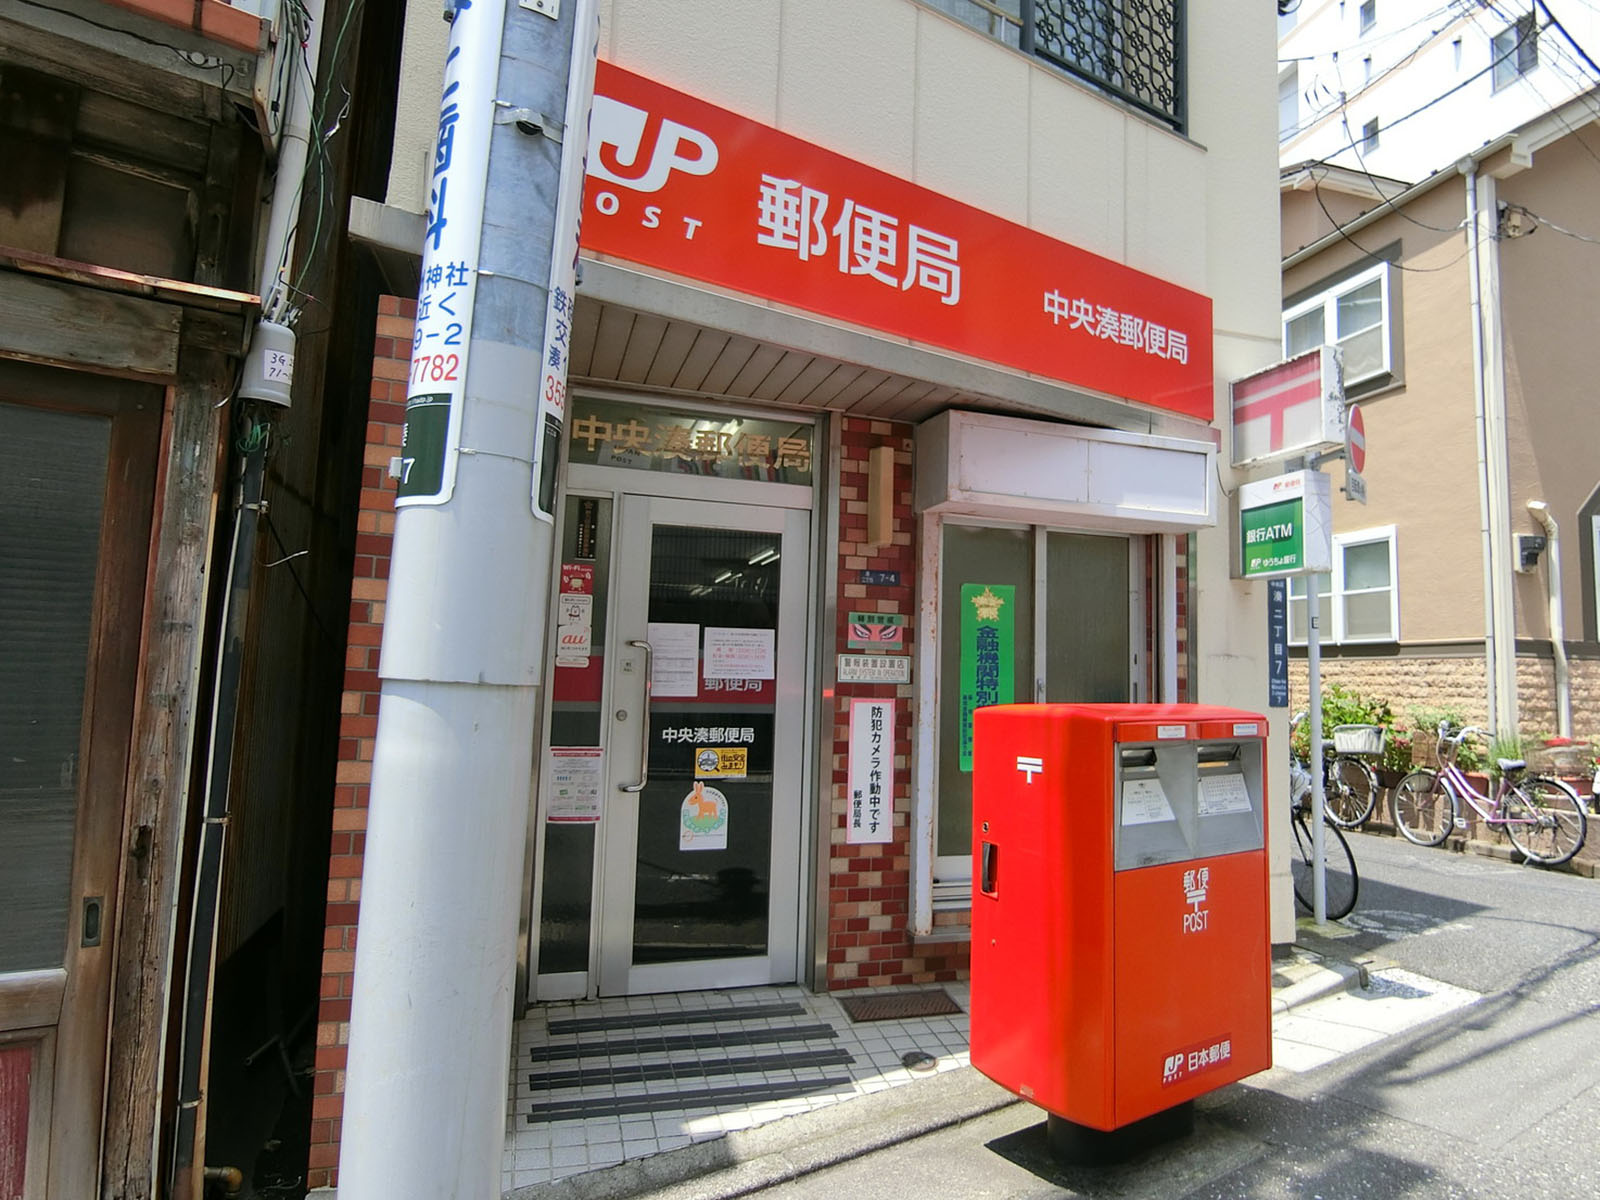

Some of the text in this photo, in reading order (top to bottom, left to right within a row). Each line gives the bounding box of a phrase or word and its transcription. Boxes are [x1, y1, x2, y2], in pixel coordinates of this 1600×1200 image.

[595, 191, 703, 241] OST
[757, 173, 961, 306] 郵便局
[422, 260, 469, 293] 神社
[1043, 289, 1188, 365] 中央湊郵便局
[572, 414, 811, 472] 中央湊郵便局
[1246, 522, 1293, 544] 銀行ATM
[1262, 554, 1297, 567] ゆうちょ銀行
[562, 633, 587, 645] au
[976, 625, 1000, 708] 金融機関特別
[704, 678, 763, 692] 郵便局
[662, 727, 755, 743] 中央湊郵便局
[868, 706, 883, 833] 防犯カメラ作動中です
[853, 790, 862, 828] 郵便局長
[1183, 867, 1209, 893] 郵便
[1183, 910, 1209, 934] POST
[1164, 1040, 1231, 1076] JP 日本郵便
